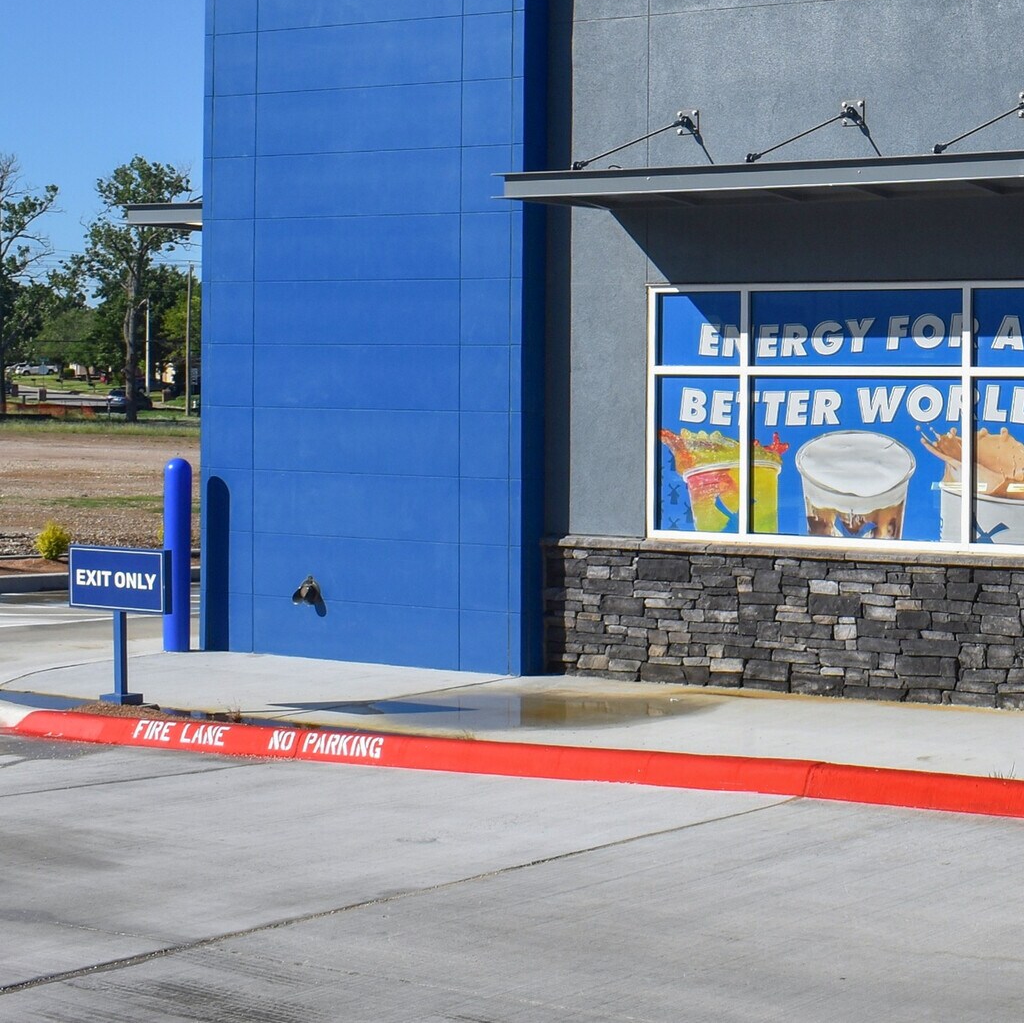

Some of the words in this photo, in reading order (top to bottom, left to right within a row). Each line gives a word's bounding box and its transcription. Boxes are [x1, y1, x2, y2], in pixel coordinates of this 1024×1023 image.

[698, 317, 876, 359] ENERGY
[885, 313, 980, 351] FOR
[990, 314, 1024, 351] A
[76, 568, 110, 588] EXIT
[114, 570, 157, 590] ONLY
[132, 719, 175, 743] FIRE
[179, 722, 231, 747] LANE
[268, 729, 296, 751] NO
[302, 732, 384, 760] PARKING
